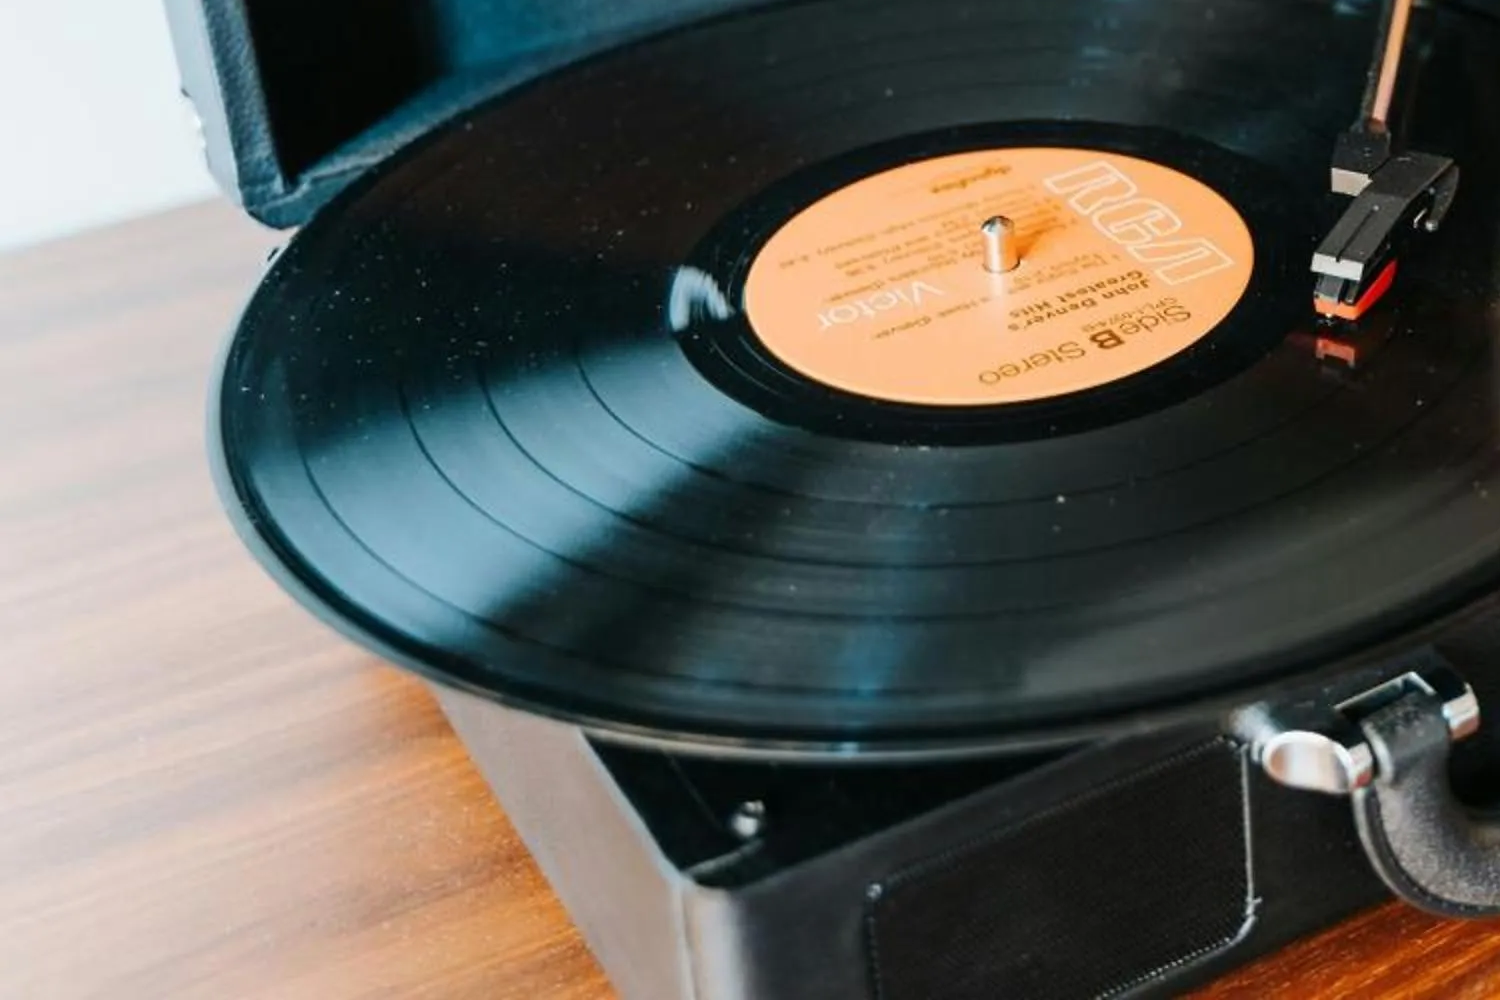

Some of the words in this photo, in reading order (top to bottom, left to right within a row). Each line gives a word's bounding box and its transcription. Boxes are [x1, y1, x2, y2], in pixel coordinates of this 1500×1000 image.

[1043, 160, 1236, 286] RCA
[1059, 269, 1144, 304] Greatest
[1101, 277, 1151, 300] John
[816, 279, 946, 332] Victor
[1007, 297, 1099, 332] Denver's
[1008, 298, 1052, 319] Hits
[1118, 303, 1193, 336] Side
[1088, 328, 1126, 350] B
[977, 340, 1088, 386] Stereo
